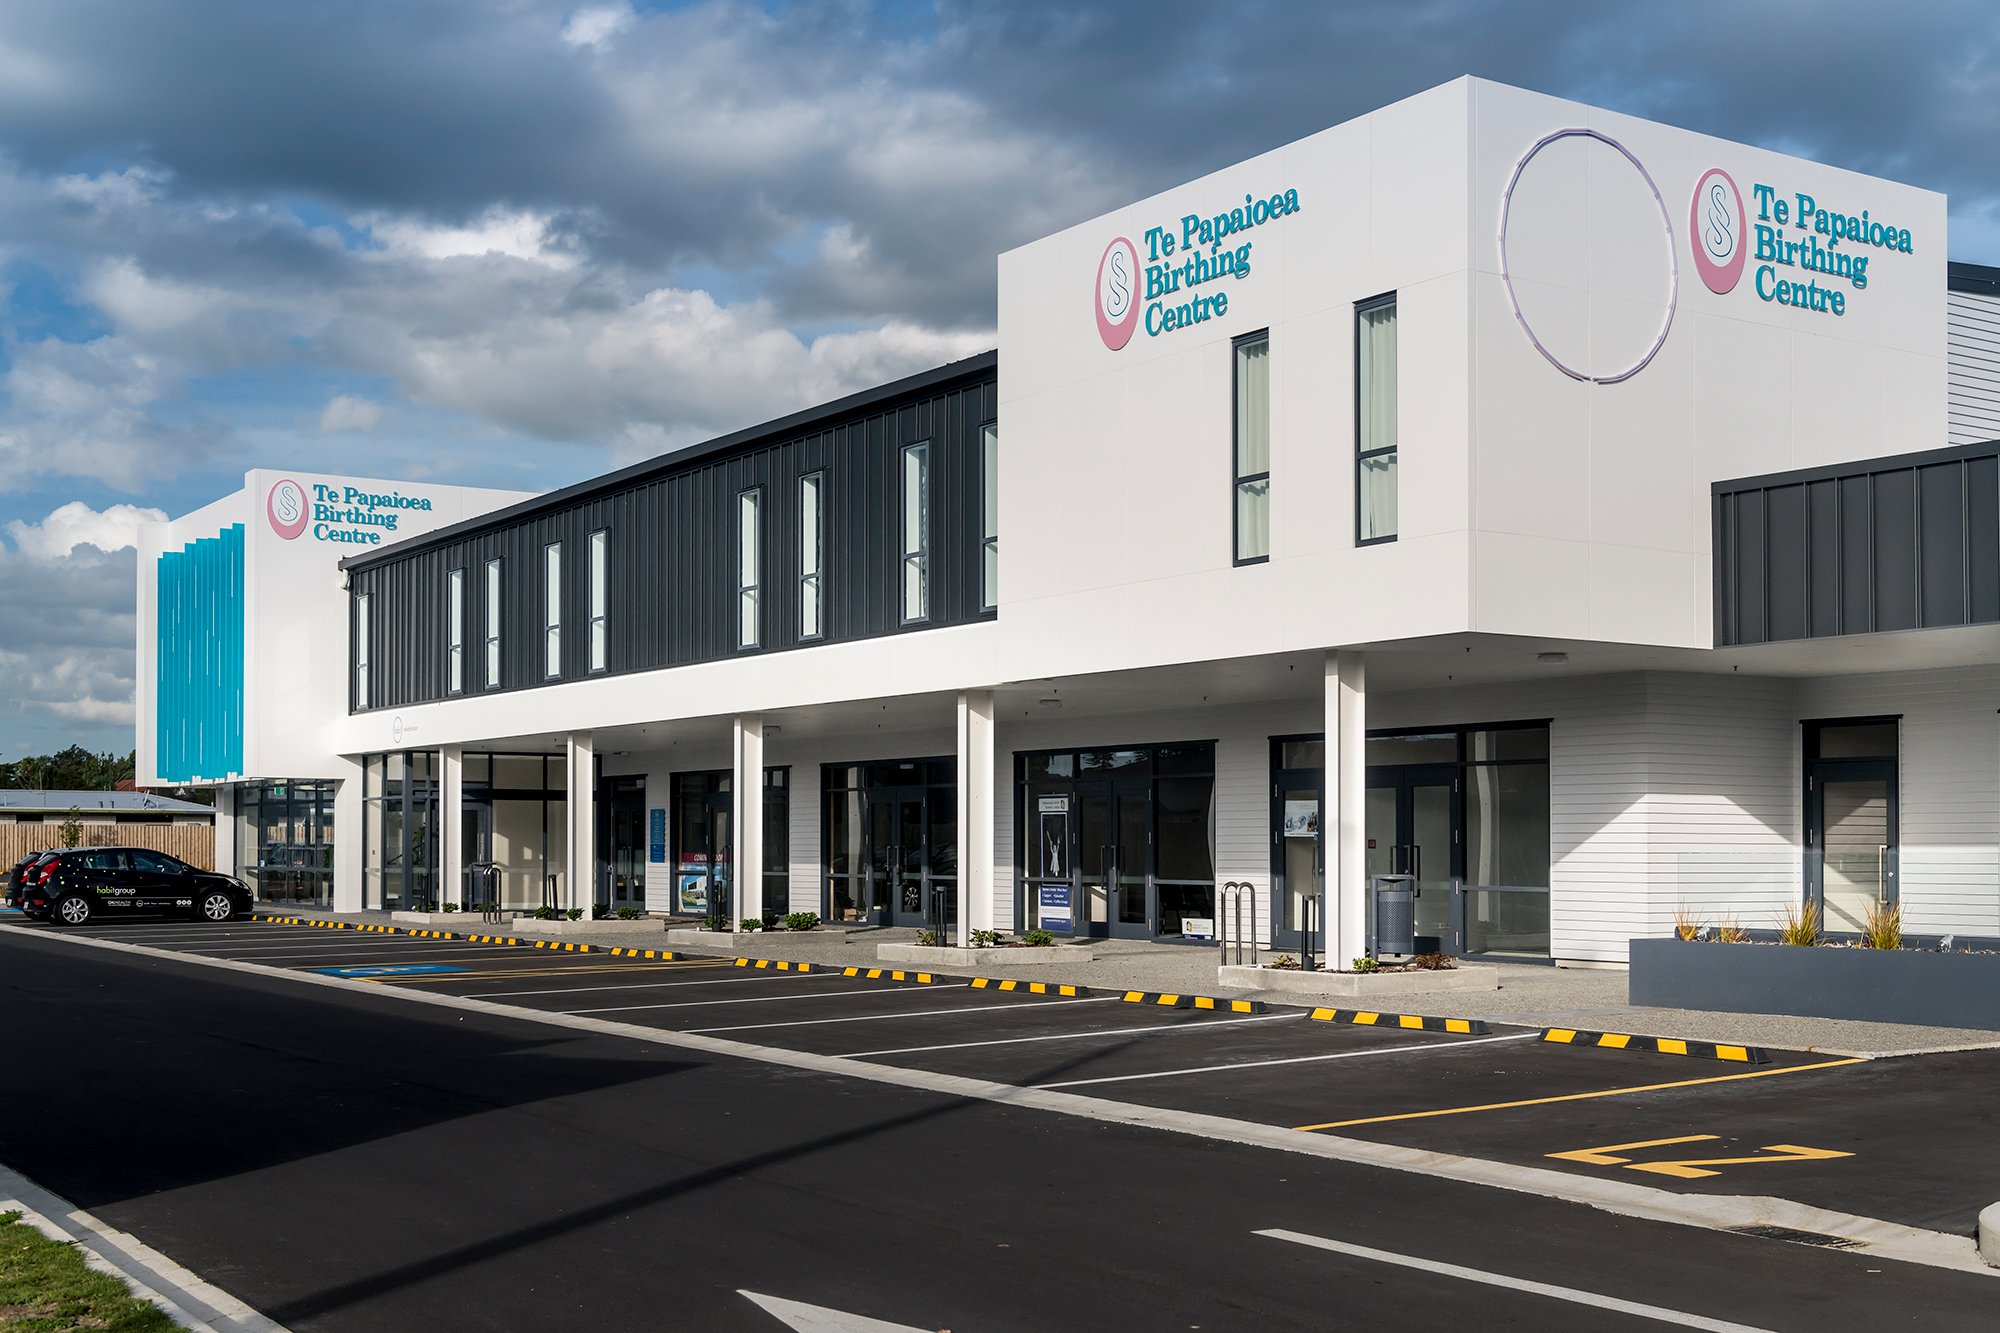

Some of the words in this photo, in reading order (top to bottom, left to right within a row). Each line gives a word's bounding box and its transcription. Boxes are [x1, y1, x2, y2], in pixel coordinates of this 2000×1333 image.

[1144, 226, 1175, 262] Te
[1180, 188, 1300, 250] Papaioea
[1753, 183, 1789, 224] Te
[1795, 192, 1913, 254] Papaioea
[1144, 241, 1252, 301] Birthing
[1753, 223, 1869, 289] Birthing
[1145, 291, 1228, 337] Centre
[1755, 264, 1845, 316] Centre
[312, 484, 340, 503] Te
[343, 486, 432, 512] Papaioea
[313, 503, 399, 531] Birthing
[313, 523, 381, 545] Centre
[96, 885, 136, 896] habitgroup
